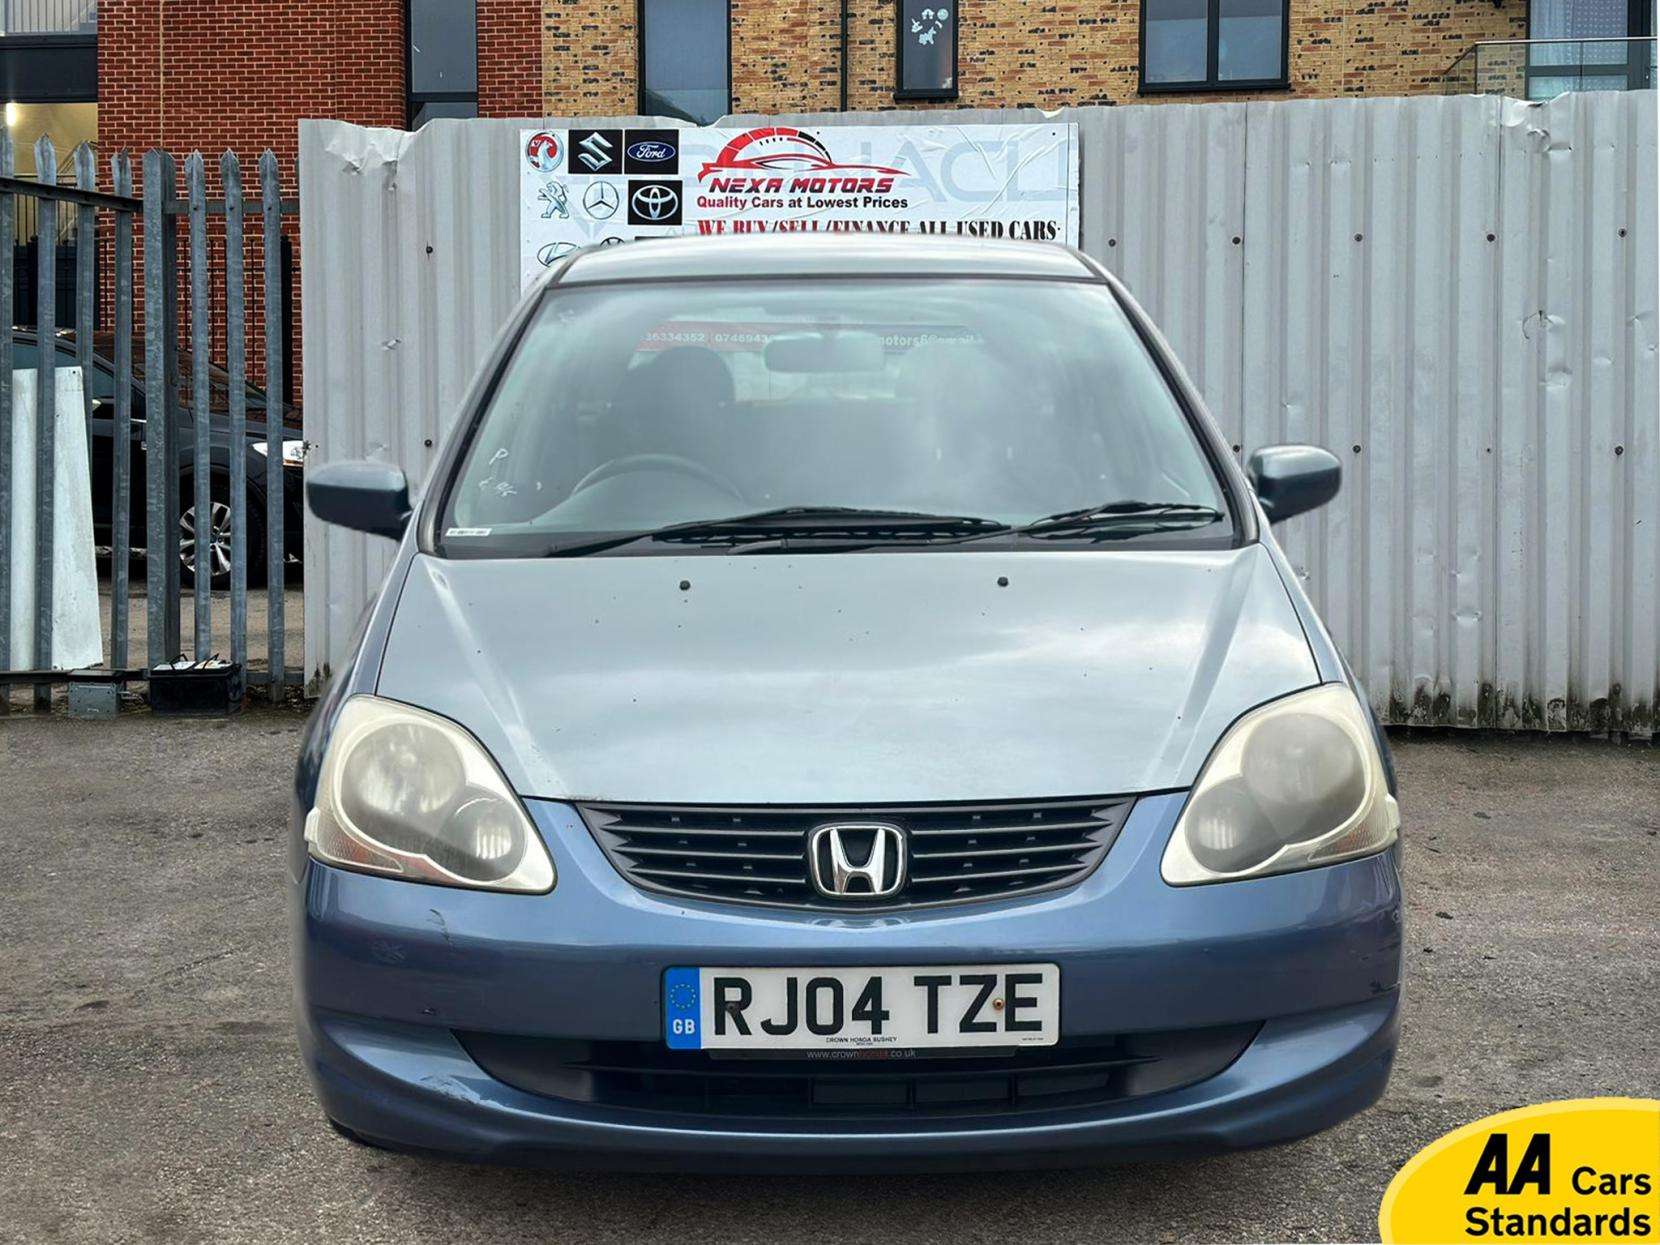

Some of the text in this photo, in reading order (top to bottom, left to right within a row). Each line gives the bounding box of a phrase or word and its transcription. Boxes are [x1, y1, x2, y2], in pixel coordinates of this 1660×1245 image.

[636, 144, 666, 159] Ford
[709, 177, 895, 194] NEXA MOTORS
[697, 196, 908, 210] Quality Cars at Lowest Prices
[956, 220, 1004, 239] USED
[1009, 220, 1057, 241] CARS
[713, 973, 1043, 1036] RJ04 TZE
[672, 1018, 696, 1035] GB
